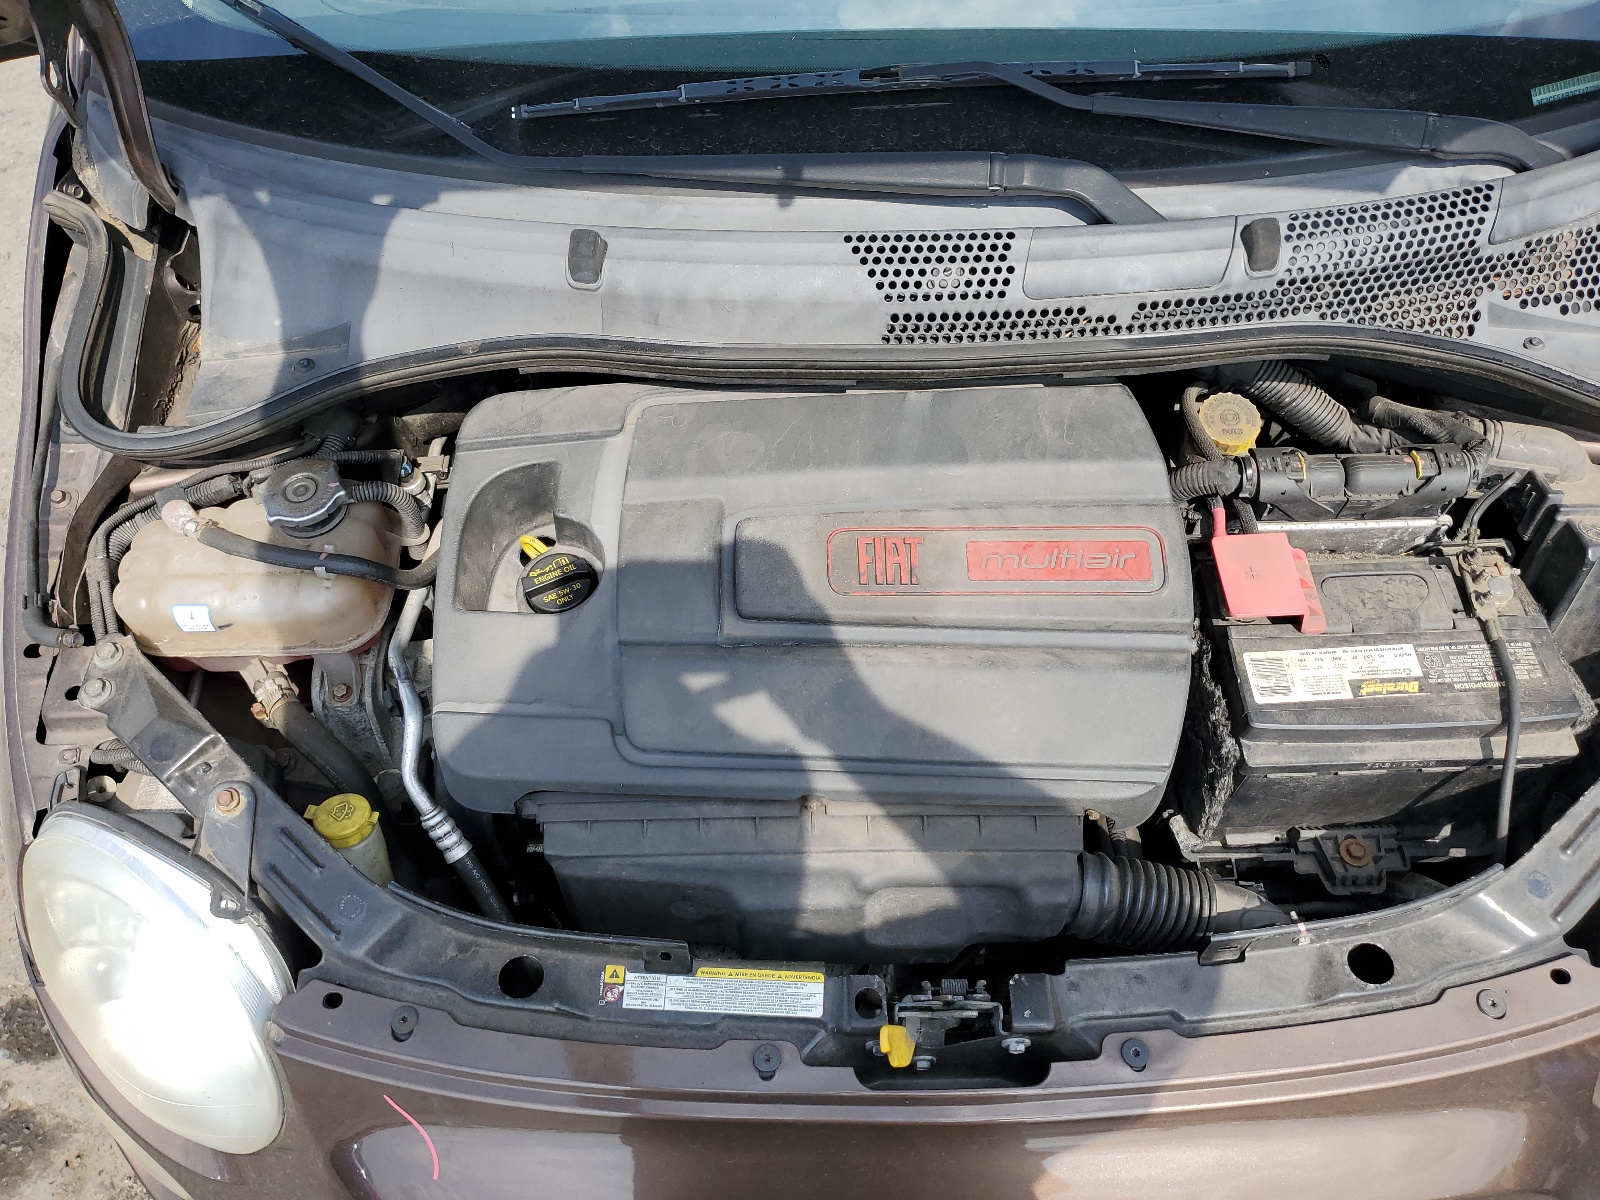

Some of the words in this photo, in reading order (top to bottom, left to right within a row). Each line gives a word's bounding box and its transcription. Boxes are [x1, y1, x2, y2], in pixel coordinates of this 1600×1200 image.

[856, 536, 924, 586] FIAT
[981, 547, 1137, 569] multiair
[533, 570, 563, 585] ENGINE
[563, 563, 578, 574] OIL
[542, 593, 557, 603] SAE
[558, 582, 582, 597] 5W-30
[556, 593, 574, 605] ONLY
[1360, 680, 1420, 696] Duralast
